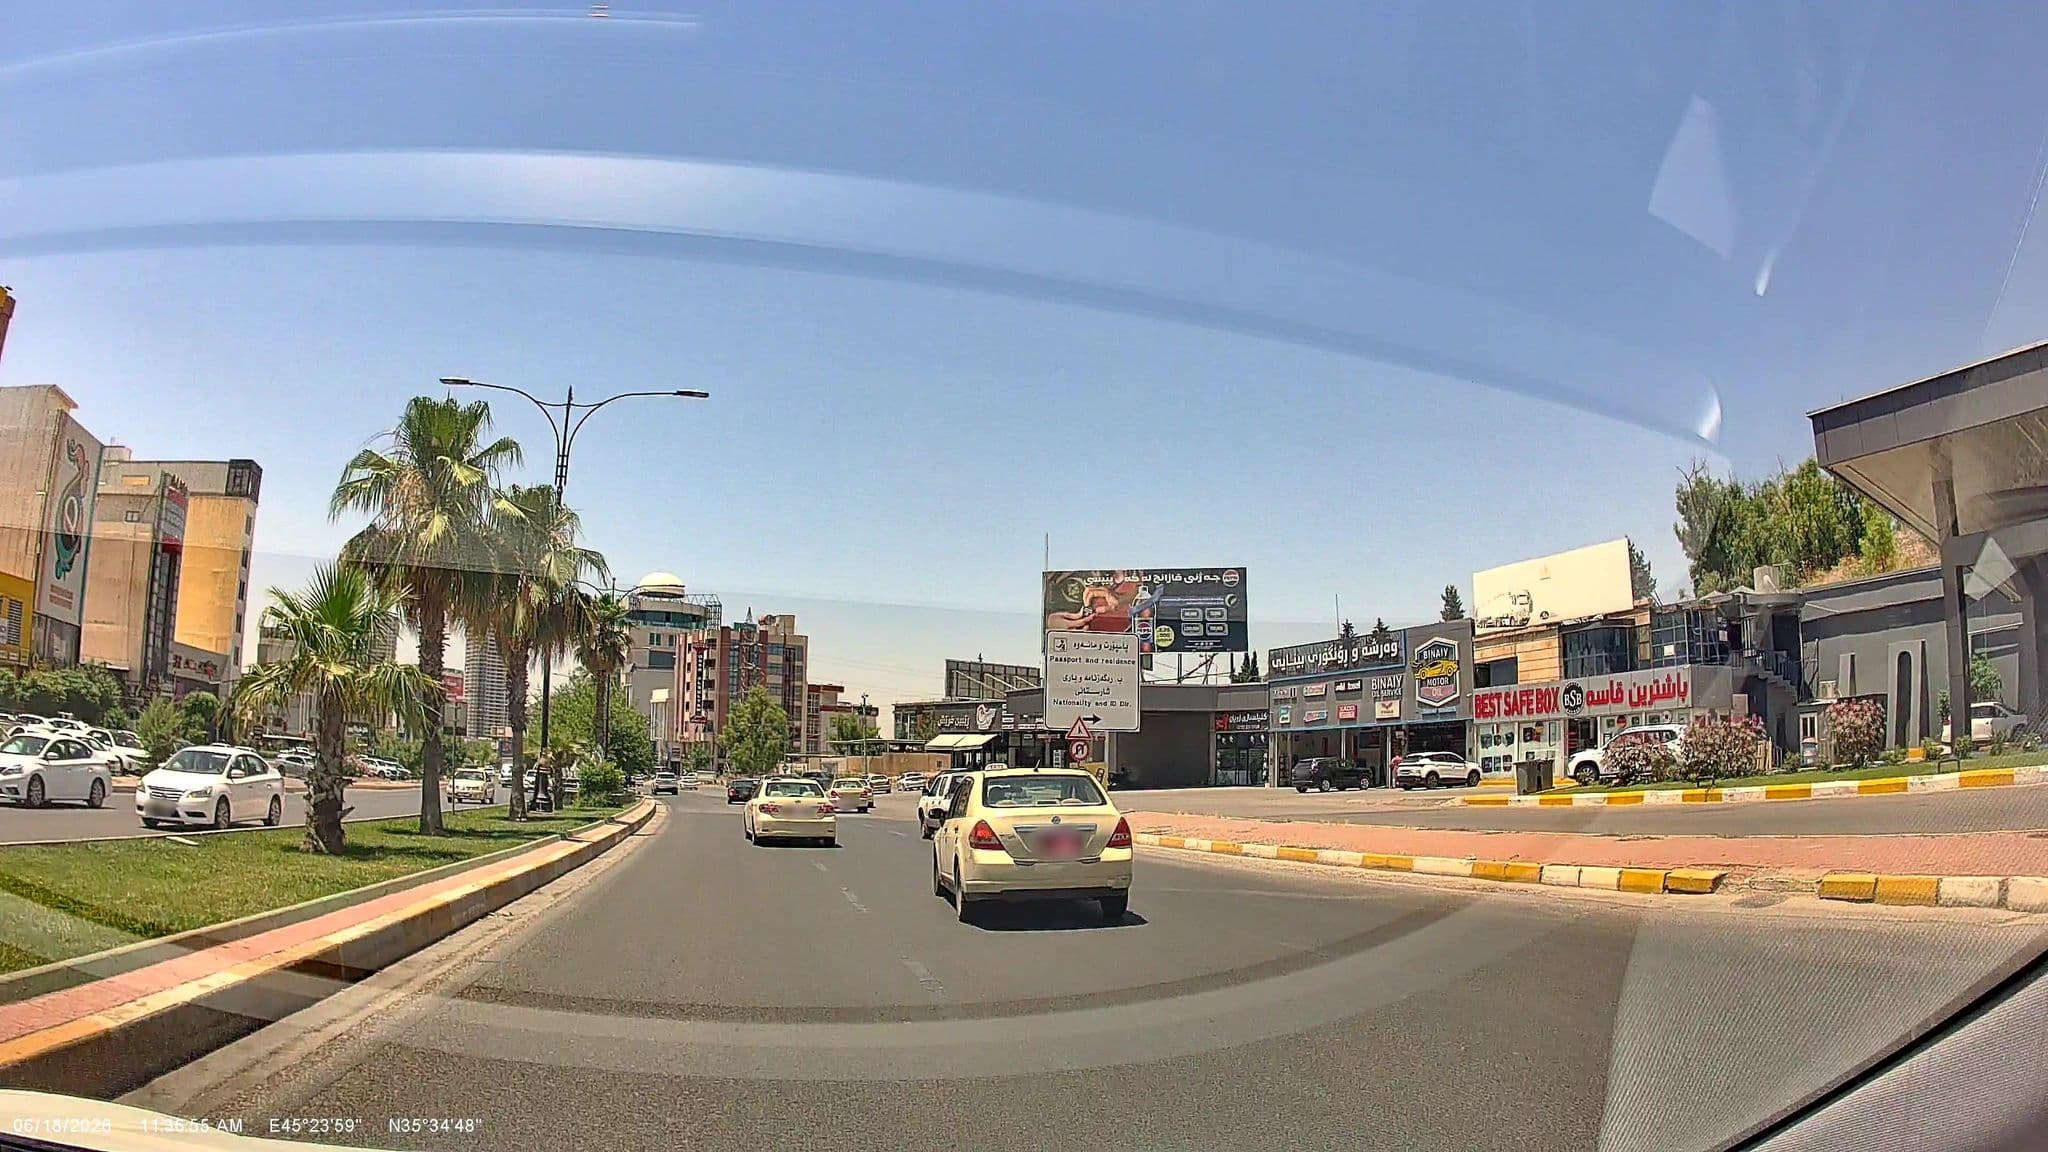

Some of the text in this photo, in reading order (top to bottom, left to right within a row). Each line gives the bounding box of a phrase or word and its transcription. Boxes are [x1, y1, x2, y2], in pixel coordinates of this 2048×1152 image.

[1351, 646, 1359, 661] و
[1423, 647, 1449, 659] BINAIY
[1049, 655, 1082, 665] Passport
[1101, 657, 1136, 665] residence
[1371, 675, 1403, 690] BINAIY
[1426, 677, 1449, 686] MOTOR
[1380, 687, 1402, 697] SERVICE
[1432, 687, 1442, 696] OIL
[1053, 698, 1091, 707] Nationality
[1474, 686, 1560, 718] BEST SAFE BOX
[1564, 689, 1582, 707] BSB
